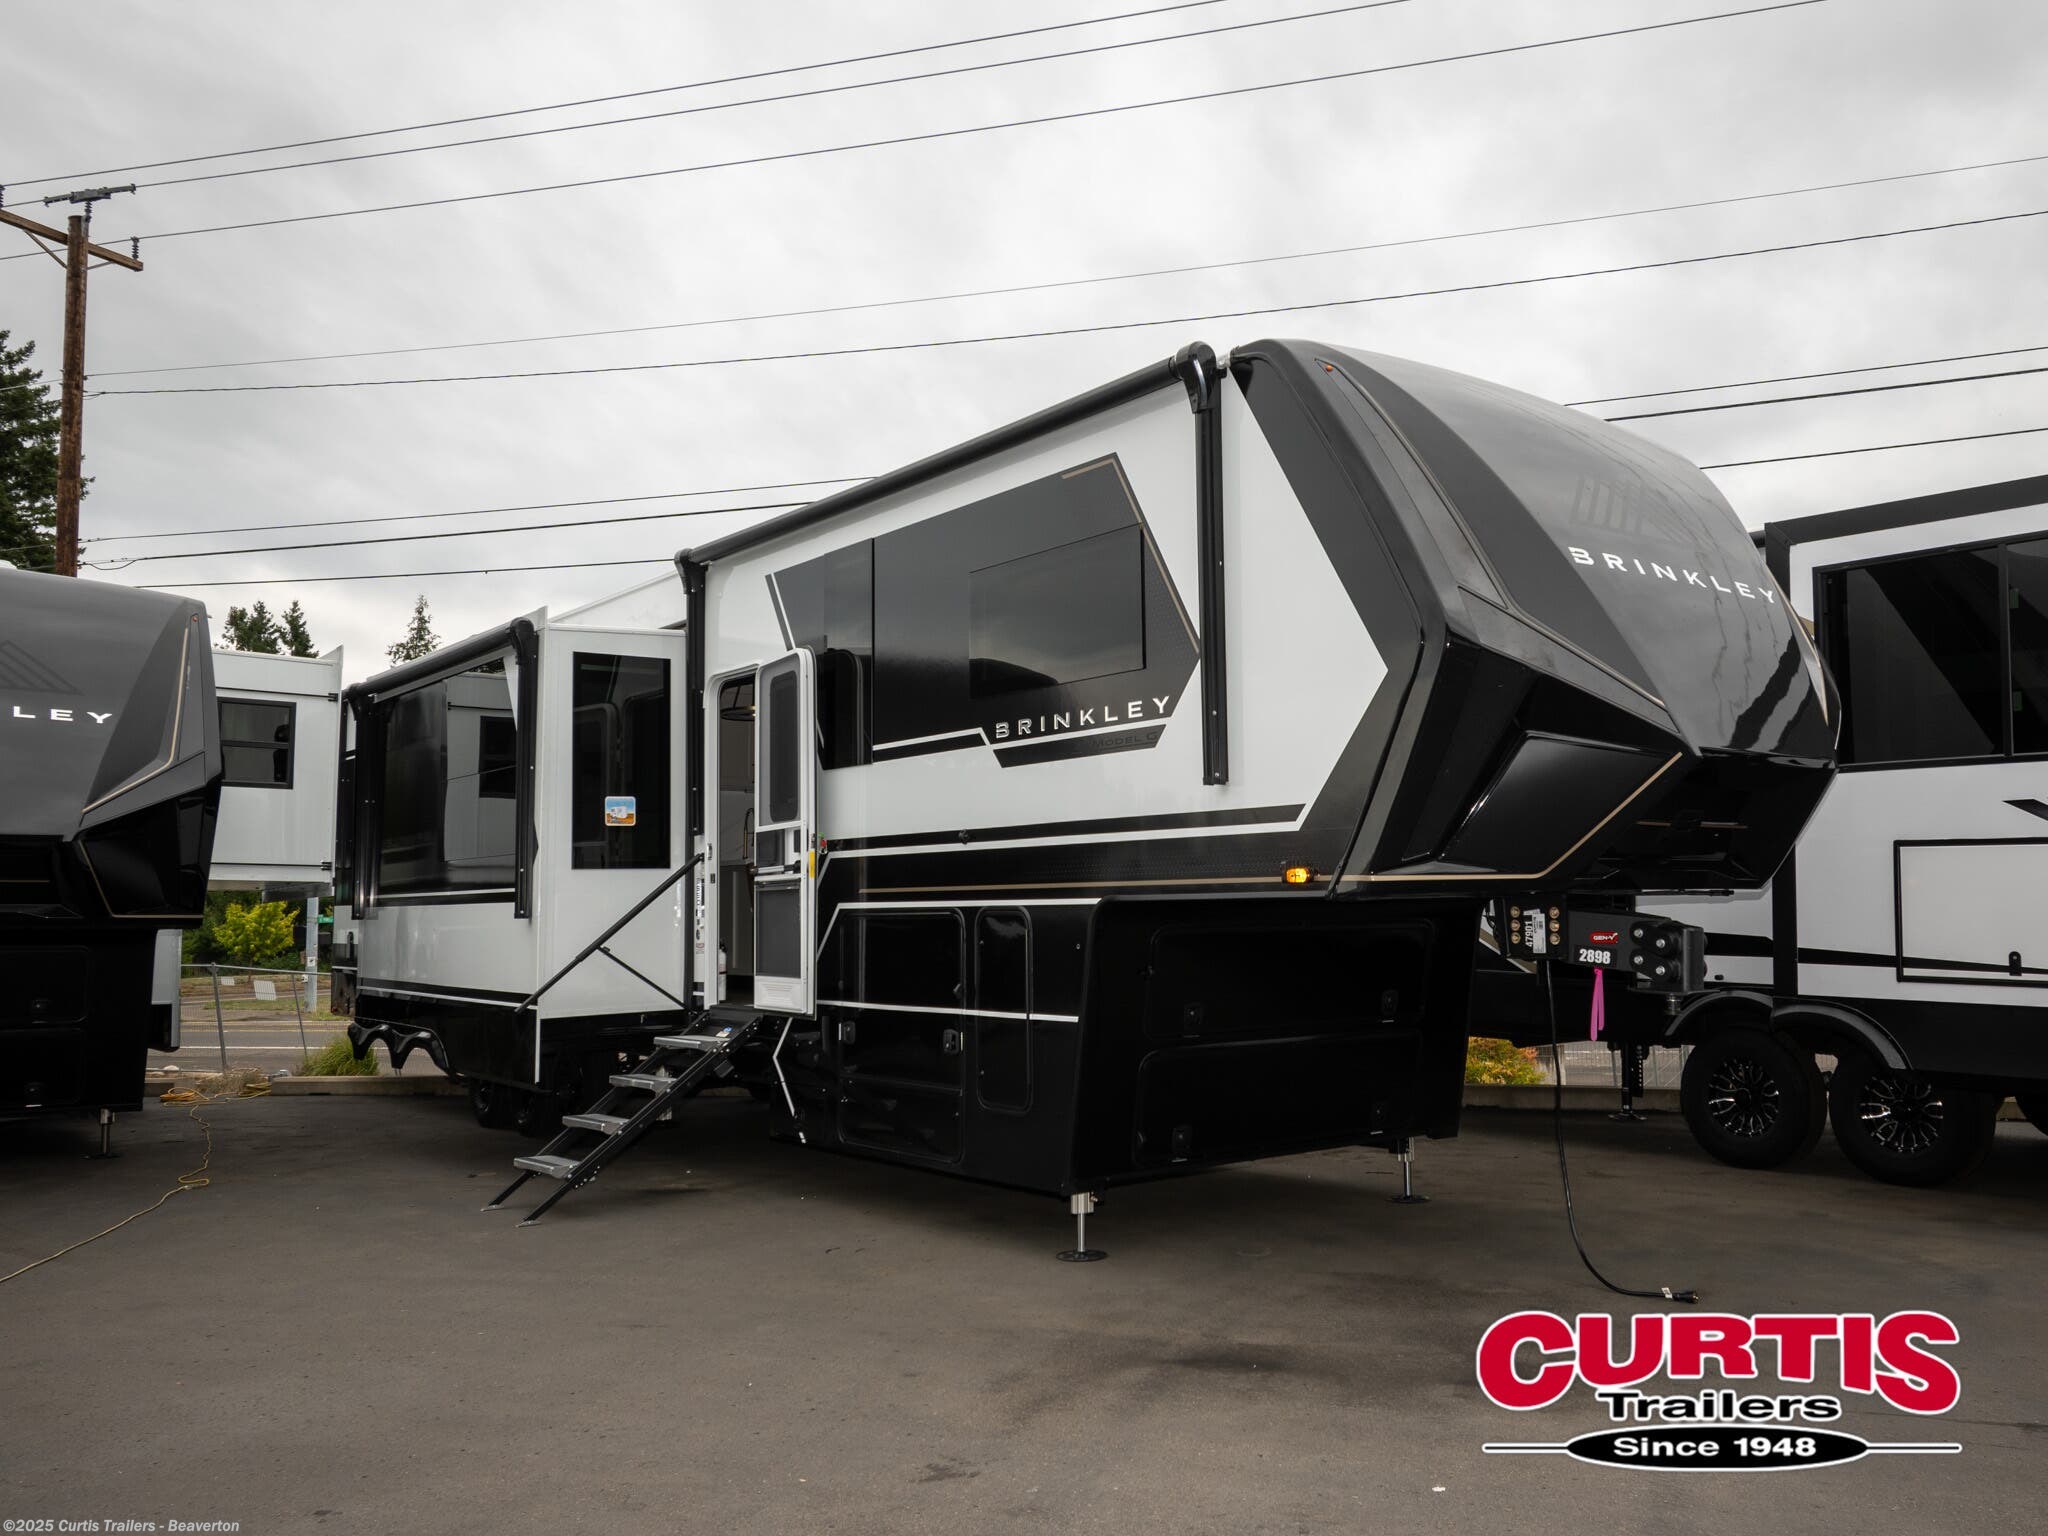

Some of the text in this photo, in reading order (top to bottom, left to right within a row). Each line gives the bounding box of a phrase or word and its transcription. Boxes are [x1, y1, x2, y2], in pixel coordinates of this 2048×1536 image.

[1568, 546, 1775, 604] BRINKLEY
[995, 696, 1170, 739] BRINKLEY
[1525, 921, 1534, 948] 47901
[1579, 948, 1611, 965] 2898
